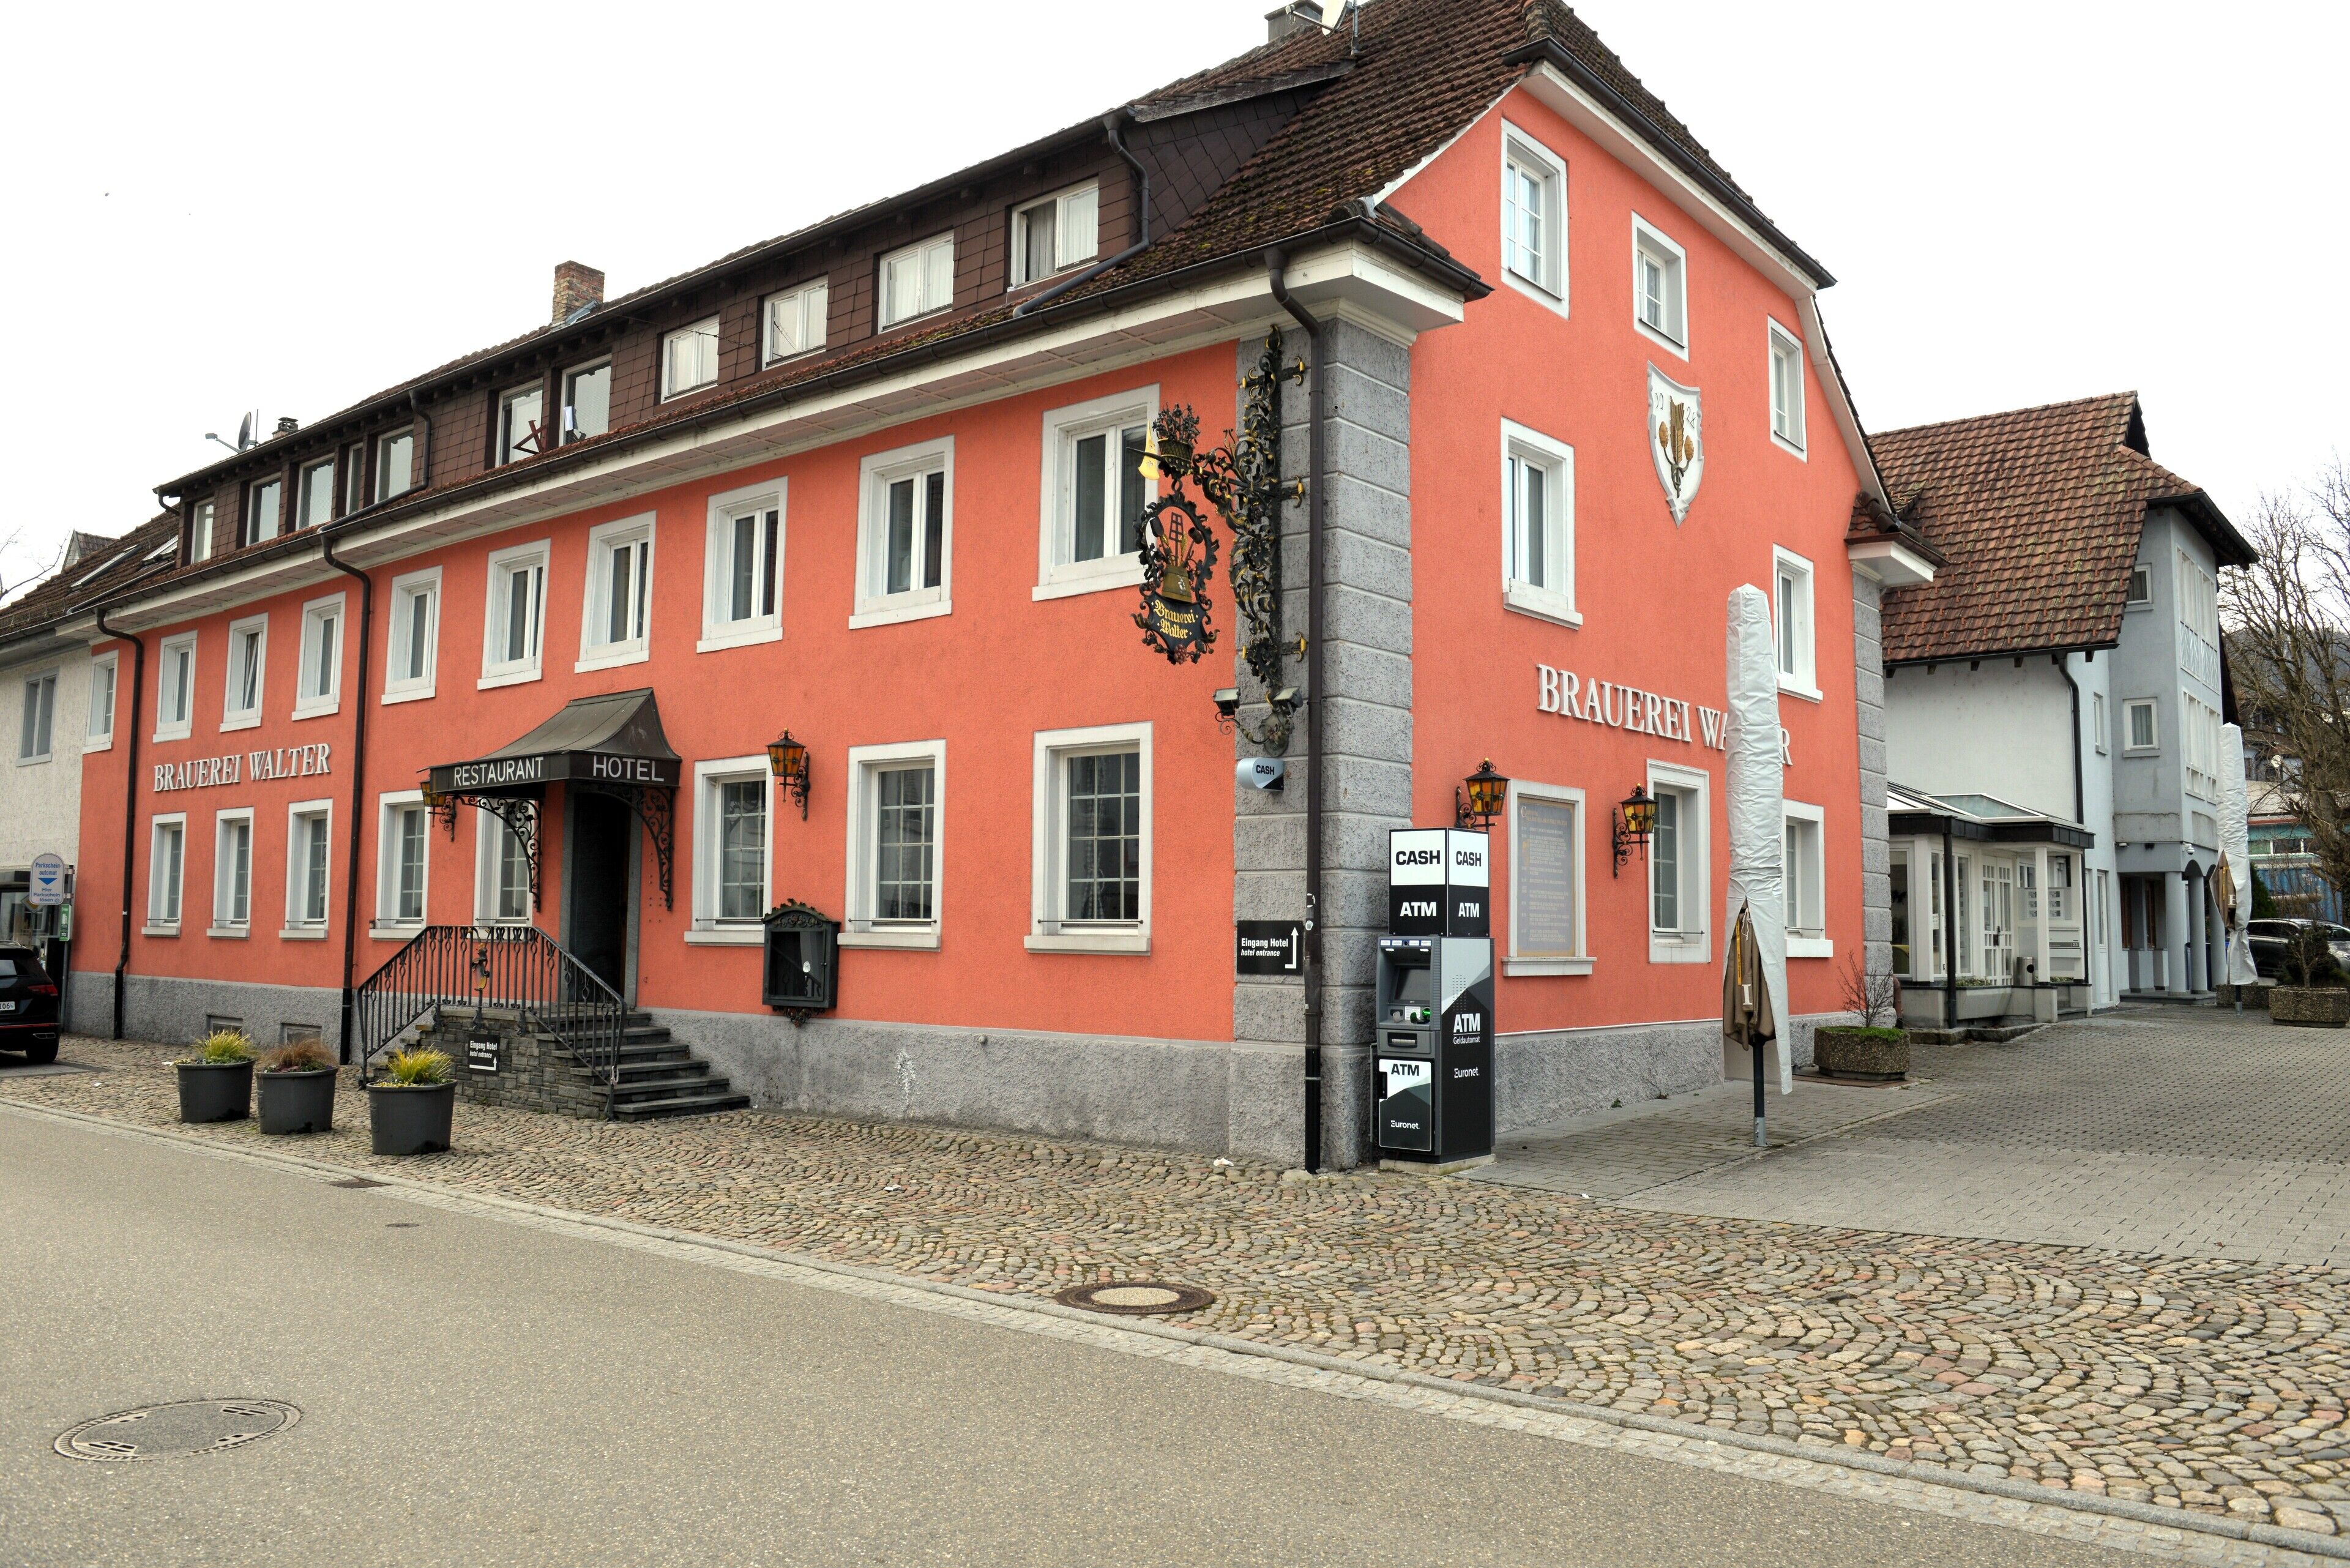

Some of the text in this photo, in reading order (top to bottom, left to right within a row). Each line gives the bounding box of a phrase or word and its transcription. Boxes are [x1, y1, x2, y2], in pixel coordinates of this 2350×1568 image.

[1153, 599, 1196, 624] Brauerei
[1160, 618, 1188, 639] Walter
[1535, 663, 1693, 742] BRAUEREI
[153, 743, 331, 792] BRAUEREI WALTER
[453, 756, 544, 786] RESTAURANT
[592, 755, 665, 782] HOTEL
[1256, 764, 1275, 775] CASH
[1396, 850, 1441, 865] CASH
[1456, 851, 1482, 867] CASH
[1400, 902, 1437, 917] ATM
[1458, 902, 1480, 917] ATM
[1241, 938, 1288, 949] Eingang Hotel
[1453, 1013, 1480, 1033] ATM
[470, 1040, 498, 1051] Eingang Hotel
[1453, 1036, 1480, 1045] Geldautomat
[1391, 1063, 1420, 1077] ATM
[1454, 1067, 1479, 1078] Euronet
[1390, 1120, 1419, 1129] Euronet
